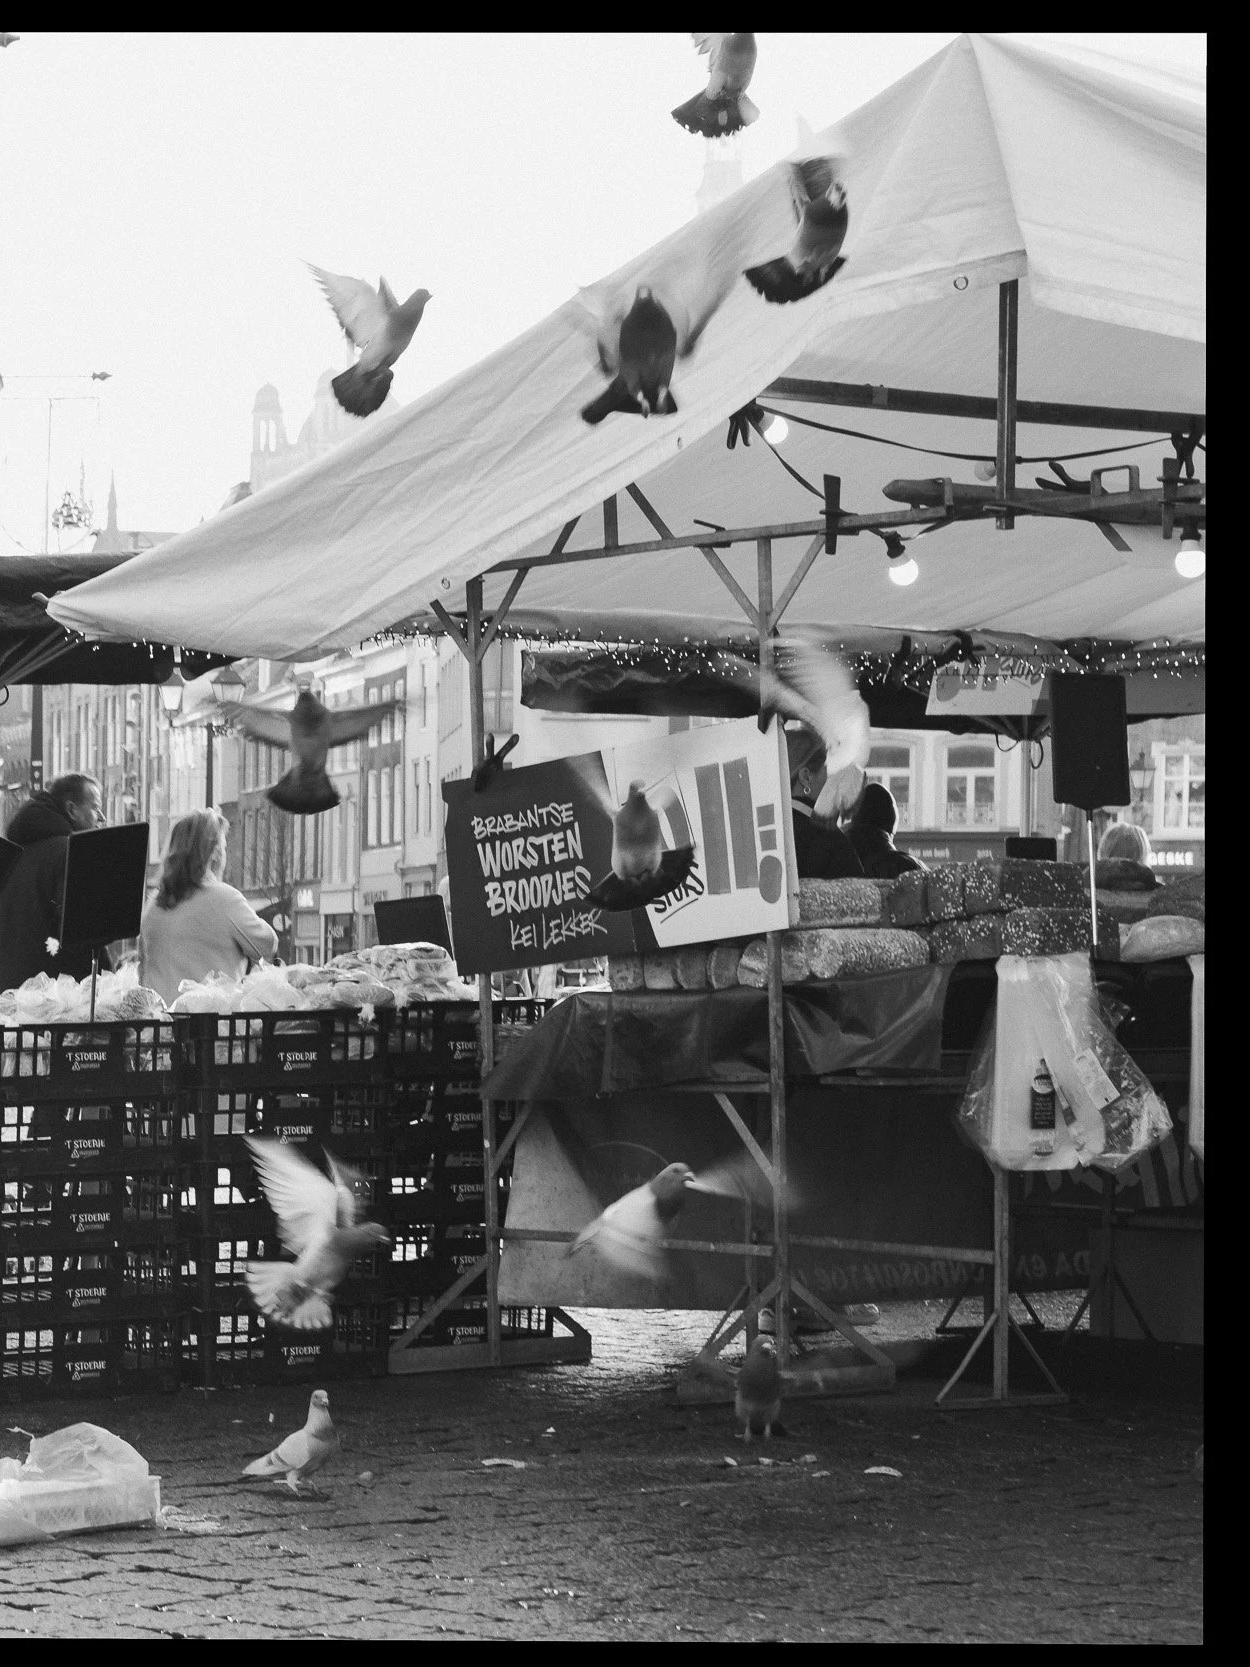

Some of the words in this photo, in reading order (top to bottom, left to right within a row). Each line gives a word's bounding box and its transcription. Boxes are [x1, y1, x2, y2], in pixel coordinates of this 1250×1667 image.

[471, 802, 574, 840] BRABANTSE
[476, 821, 584, 878] WORSTEN
[483, 865, 592, 917] BROODJES
[509, 919, 538, 951] KEI
[541, 908, 608, 950] LEKKER
